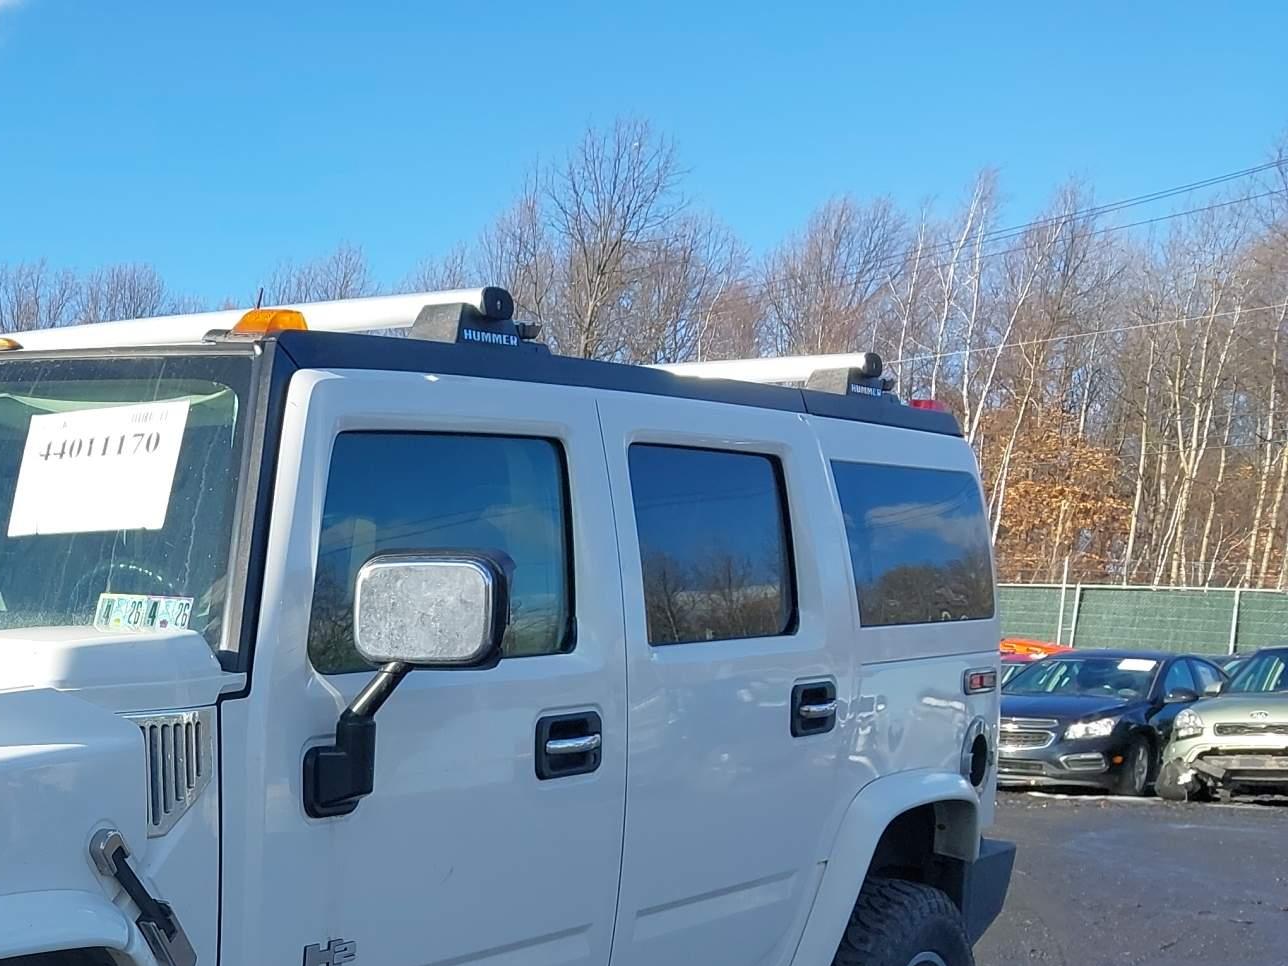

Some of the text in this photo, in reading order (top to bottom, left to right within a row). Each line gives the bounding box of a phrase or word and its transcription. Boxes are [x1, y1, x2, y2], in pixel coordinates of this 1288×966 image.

[463, 328, 519, 346] HUMMER
[850, 383, 882, 397] HUMMER
[39, 431, 161, 461] 44011170
[127, 600, 143, 625] 26
[147, 601, 190, 628] 4 26
